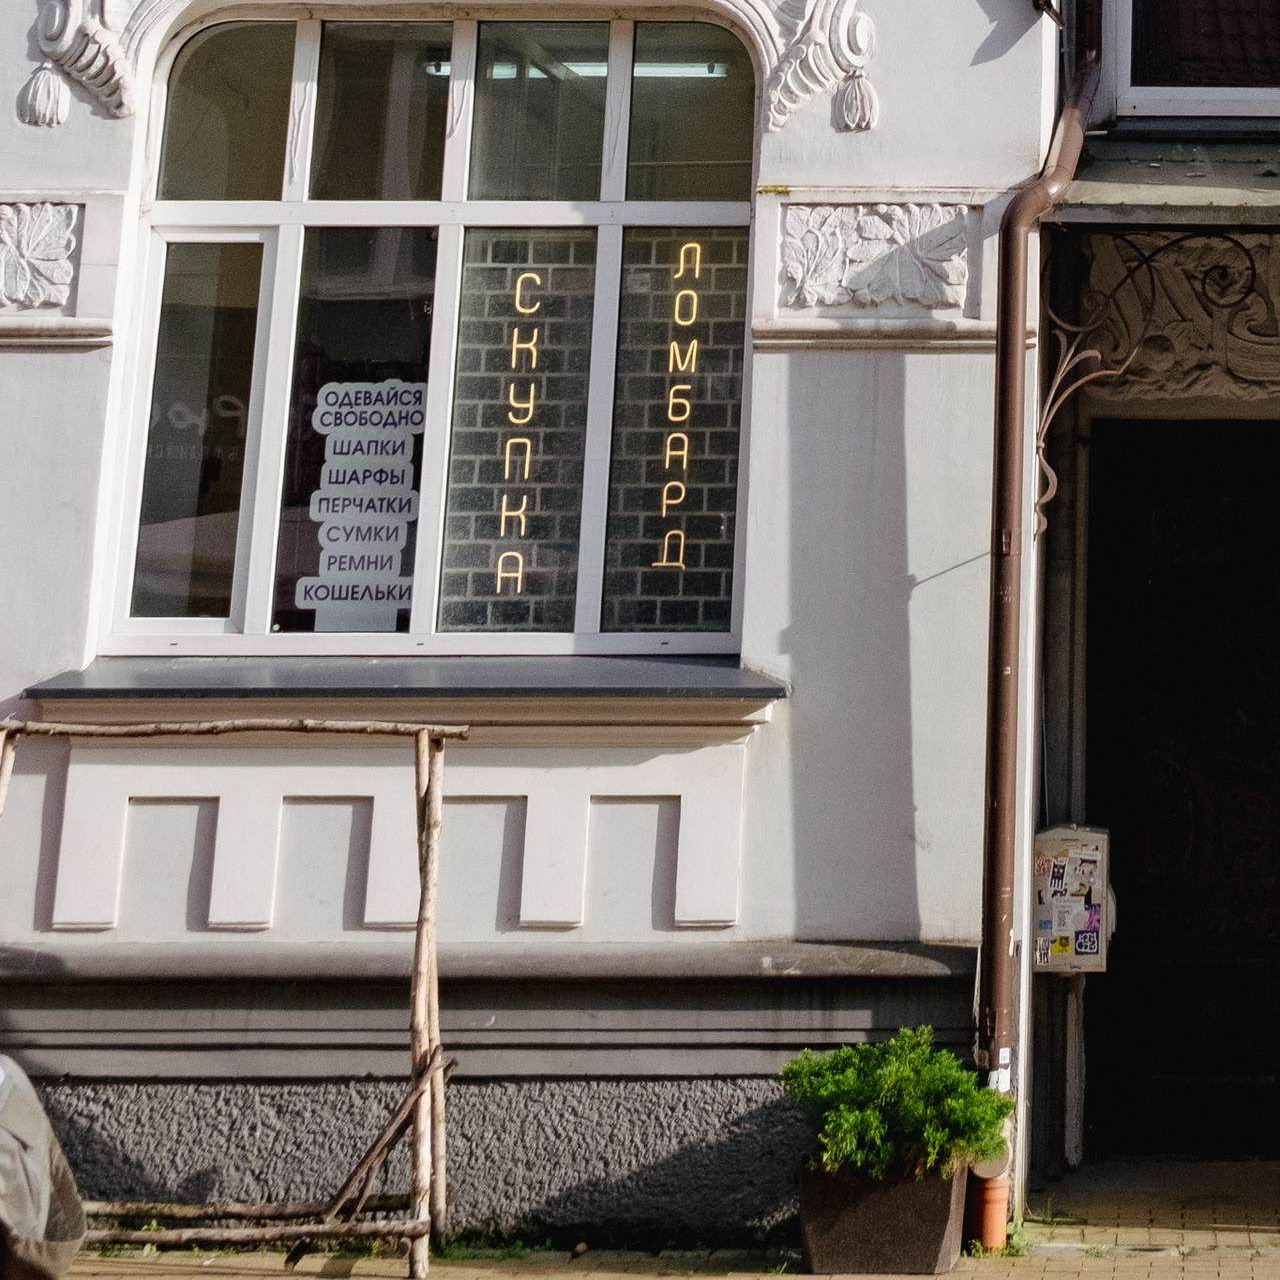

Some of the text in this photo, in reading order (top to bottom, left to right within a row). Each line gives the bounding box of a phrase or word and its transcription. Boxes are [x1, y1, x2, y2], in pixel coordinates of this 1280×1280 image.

[324, 386, 423, 409] ОДЕВАЙСЯ
[651, 242, 701, 570] ЛОМБАРД
[320, 410, 425, 429] СВОБОДНО
[496, 272, 541, 594] СКУПКА
[332, 440, 406, 456] ШАПКИ
[327, 468, 406, 486] ШАРФЫ
[318, 497, 412, 514] ПЕРЧАТКИ
[326, 525, 399, 542] СУМКИ
[327, 555, 394, 571] РЕМНИ
[303, 584, 413, 601] КОШЕЛЬКИ
